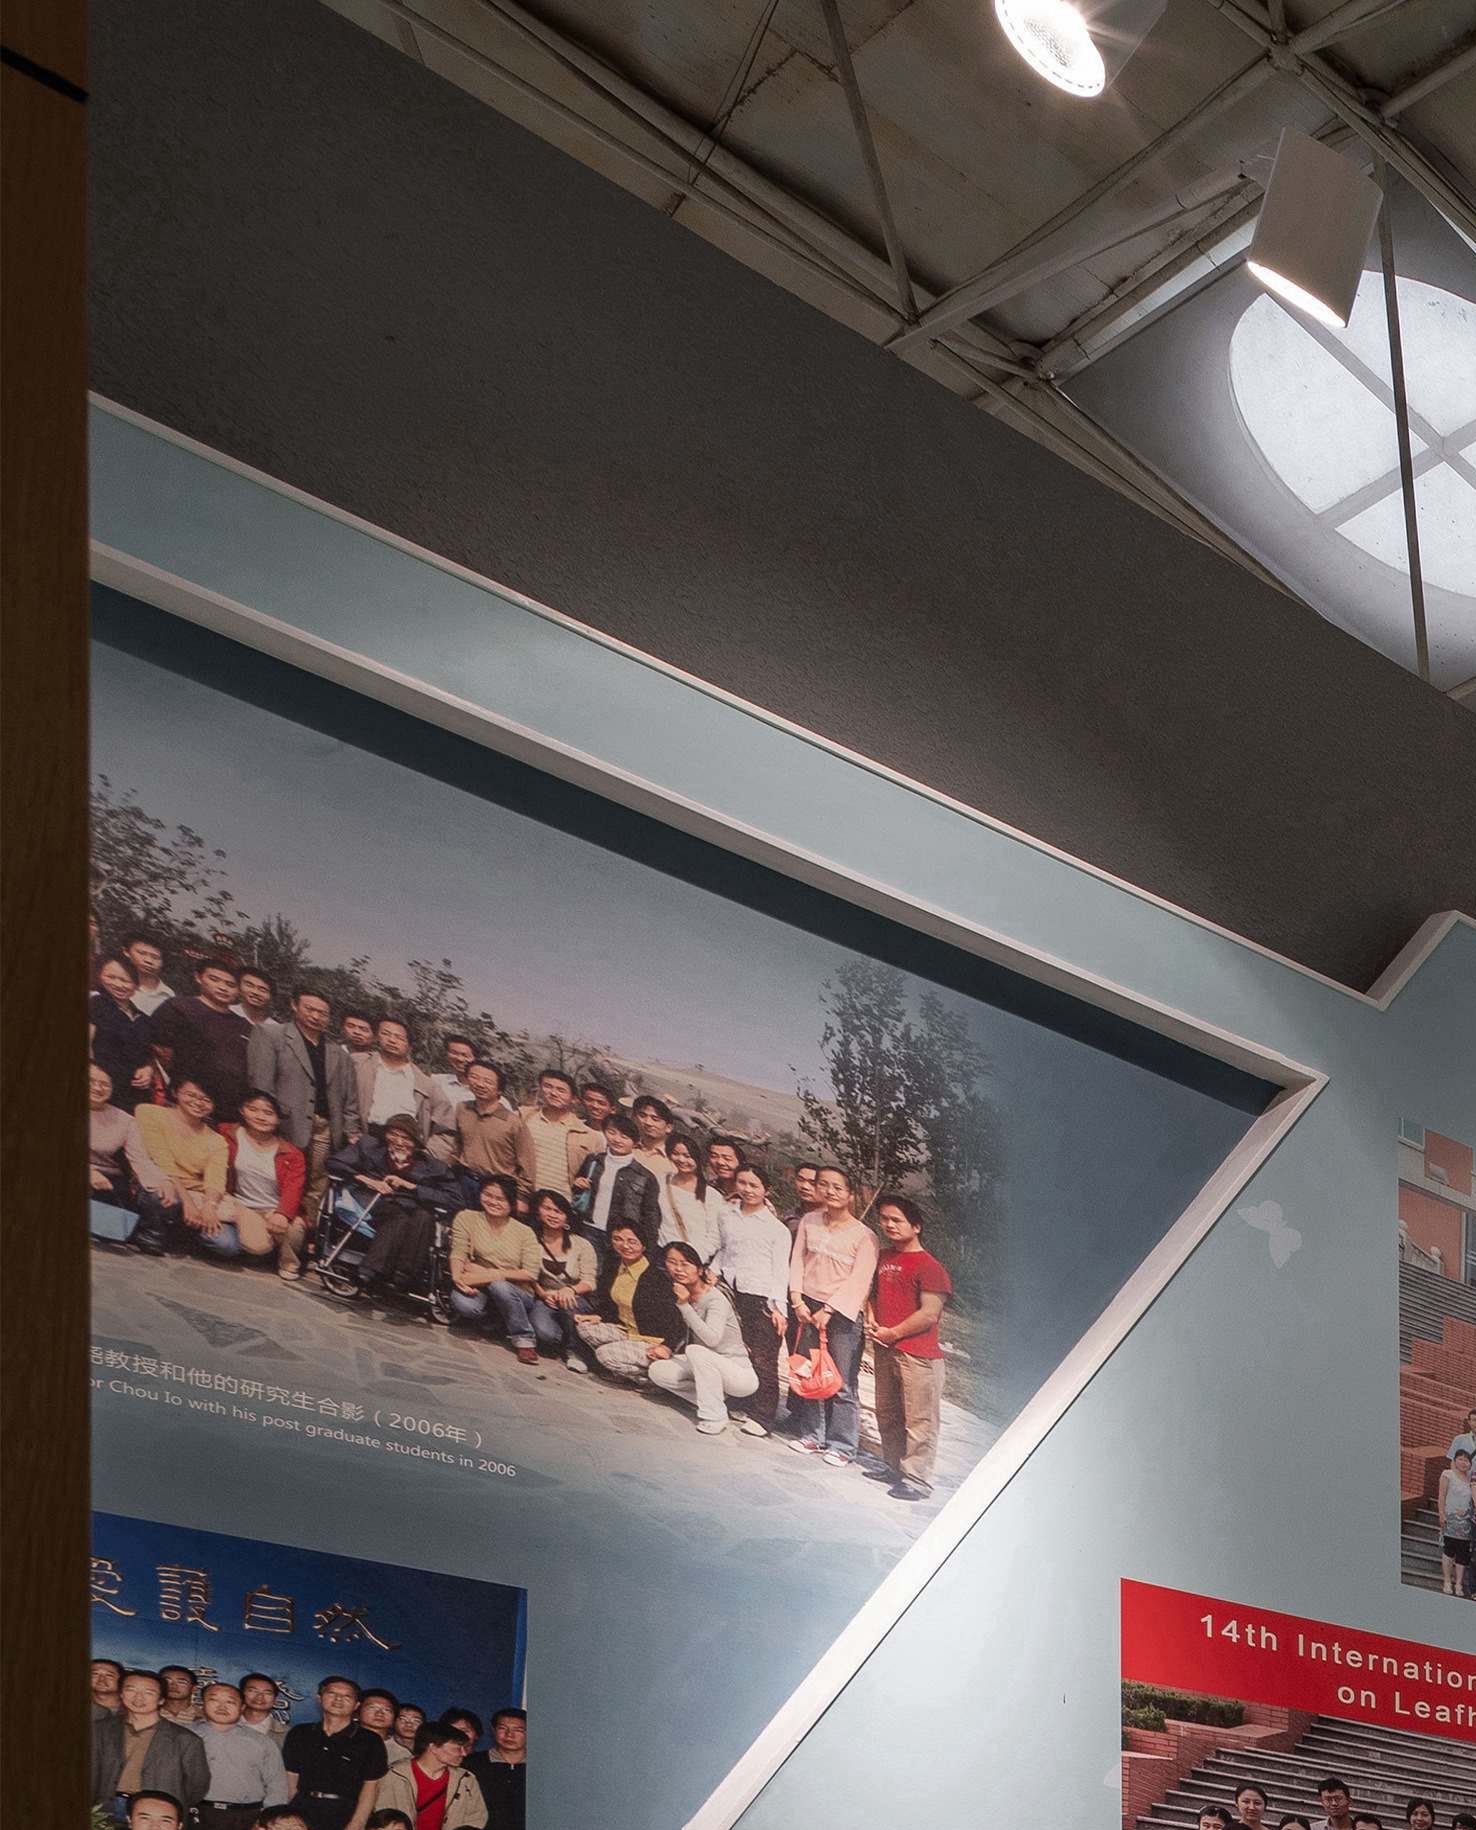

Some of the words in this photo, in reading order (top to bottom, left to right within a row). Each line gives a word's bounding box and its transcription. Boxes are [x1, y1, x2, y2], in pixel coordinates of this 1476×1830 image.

[109, 1380, 158, 1400] Chou
[165, 1391, 182, 1405] Io
[188, 1400, 226, 1415] with
[233, 1406, 256, 1423] his
[263, 1416, 300, 1431] post
[306, 1424, 380, 1448] graduate
[386, 1442, 455, 1463] students
[460, 1455, 473, 1467] in
[478, 1459, 516, 1476] 2006
[1200, 1614, 1278, 1651] 14th
[1337, 1686, 1377, 1708] on
